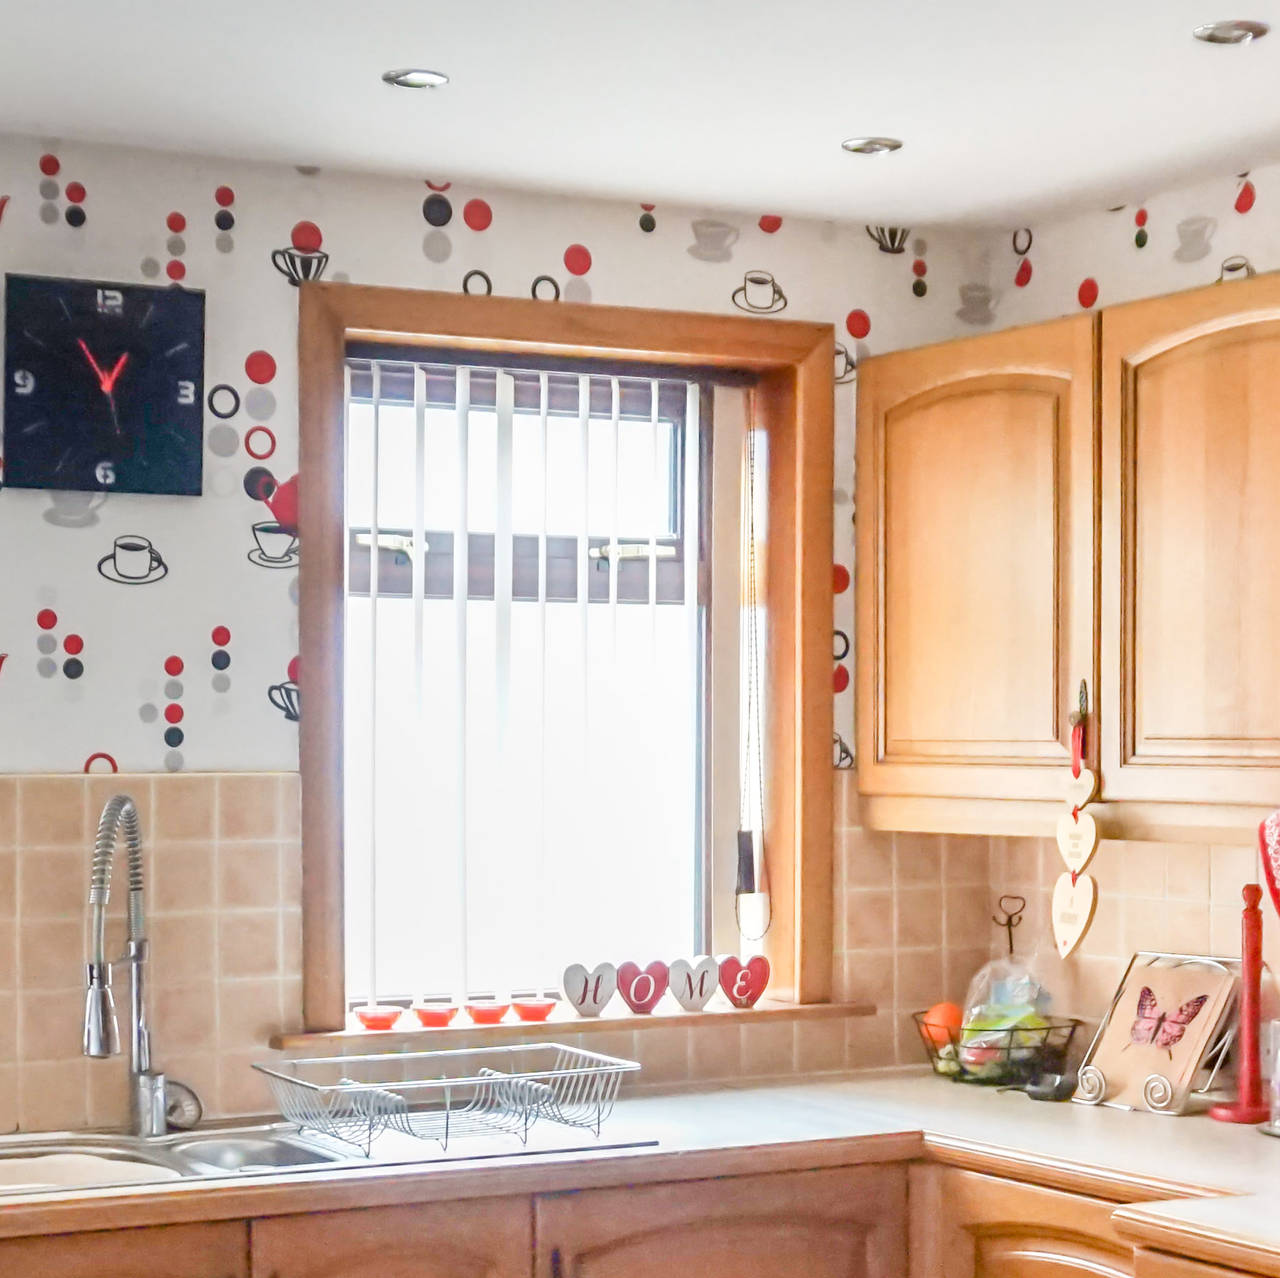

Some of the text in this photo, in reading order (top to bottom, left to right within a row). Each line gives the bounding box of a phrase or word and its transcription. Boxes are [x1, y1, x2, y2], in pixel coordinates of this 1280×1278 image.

[14, 369, 35, 395] 9
[177, 380, 195, 405] 3
[95, 461, 116, 485] 6
